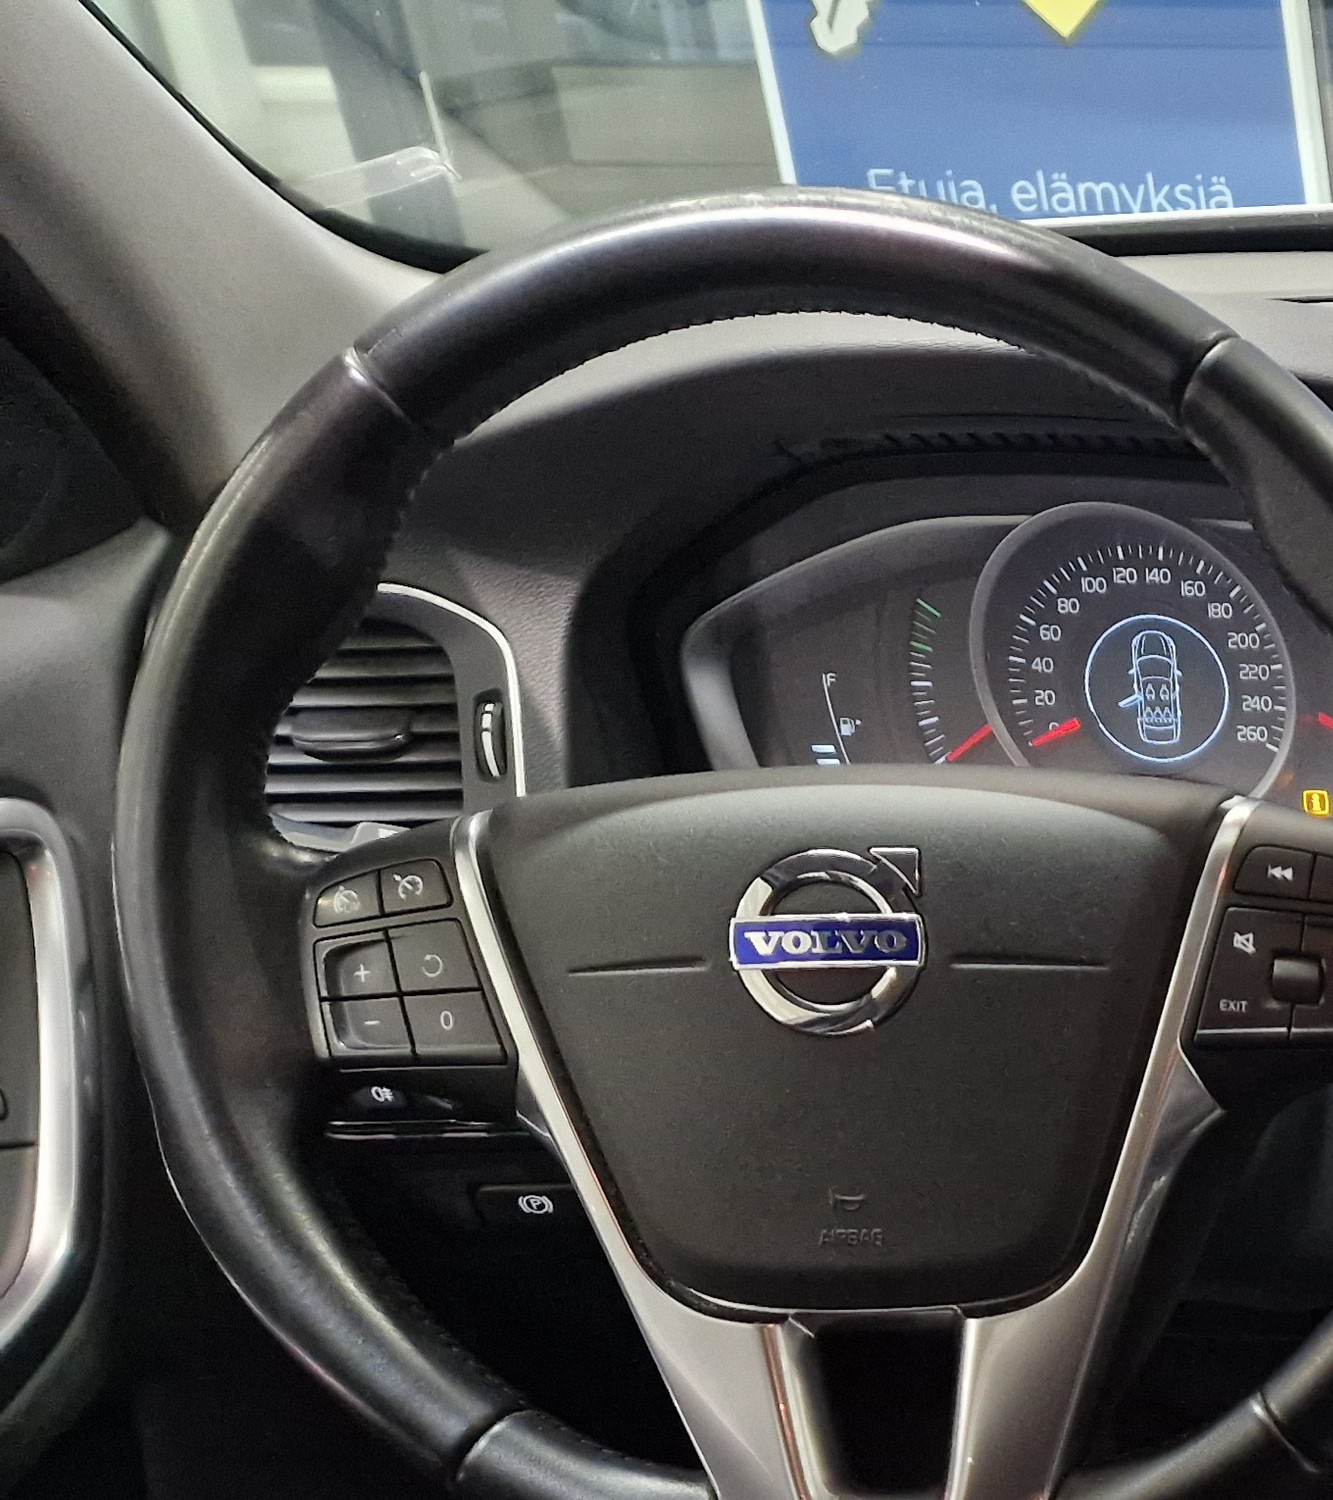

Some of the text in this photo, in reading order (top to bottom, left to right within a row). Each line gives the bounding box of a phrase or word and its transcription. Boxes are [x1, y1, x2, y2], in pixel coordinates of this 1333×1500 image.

[1113, 567, 1137, 583] 120
[1146, 568, 1171, 584] 140
[1081, 577, 1106, 593] 100
[1181, 580, 1205, 597] 160
[1058, 598, 1079, 614] 80
[1208, 603, 1232, 619] 180
[1040, 625, 1061, 641] 60
[1228, 632, 1259, 649] 200
[1031, 657, 1053, 673] 40
[1240, 664, 1269, 681] 220
[826, 673, 837, 687] F
[1035, 690, 1055, 706] 20
[1242, 695, 1272, 712] 240
[1237, 726, 1267, 742] 260
[744, 930, 907, 957] VOLVO
[1219, 999, 1248, 1013] EXIT
